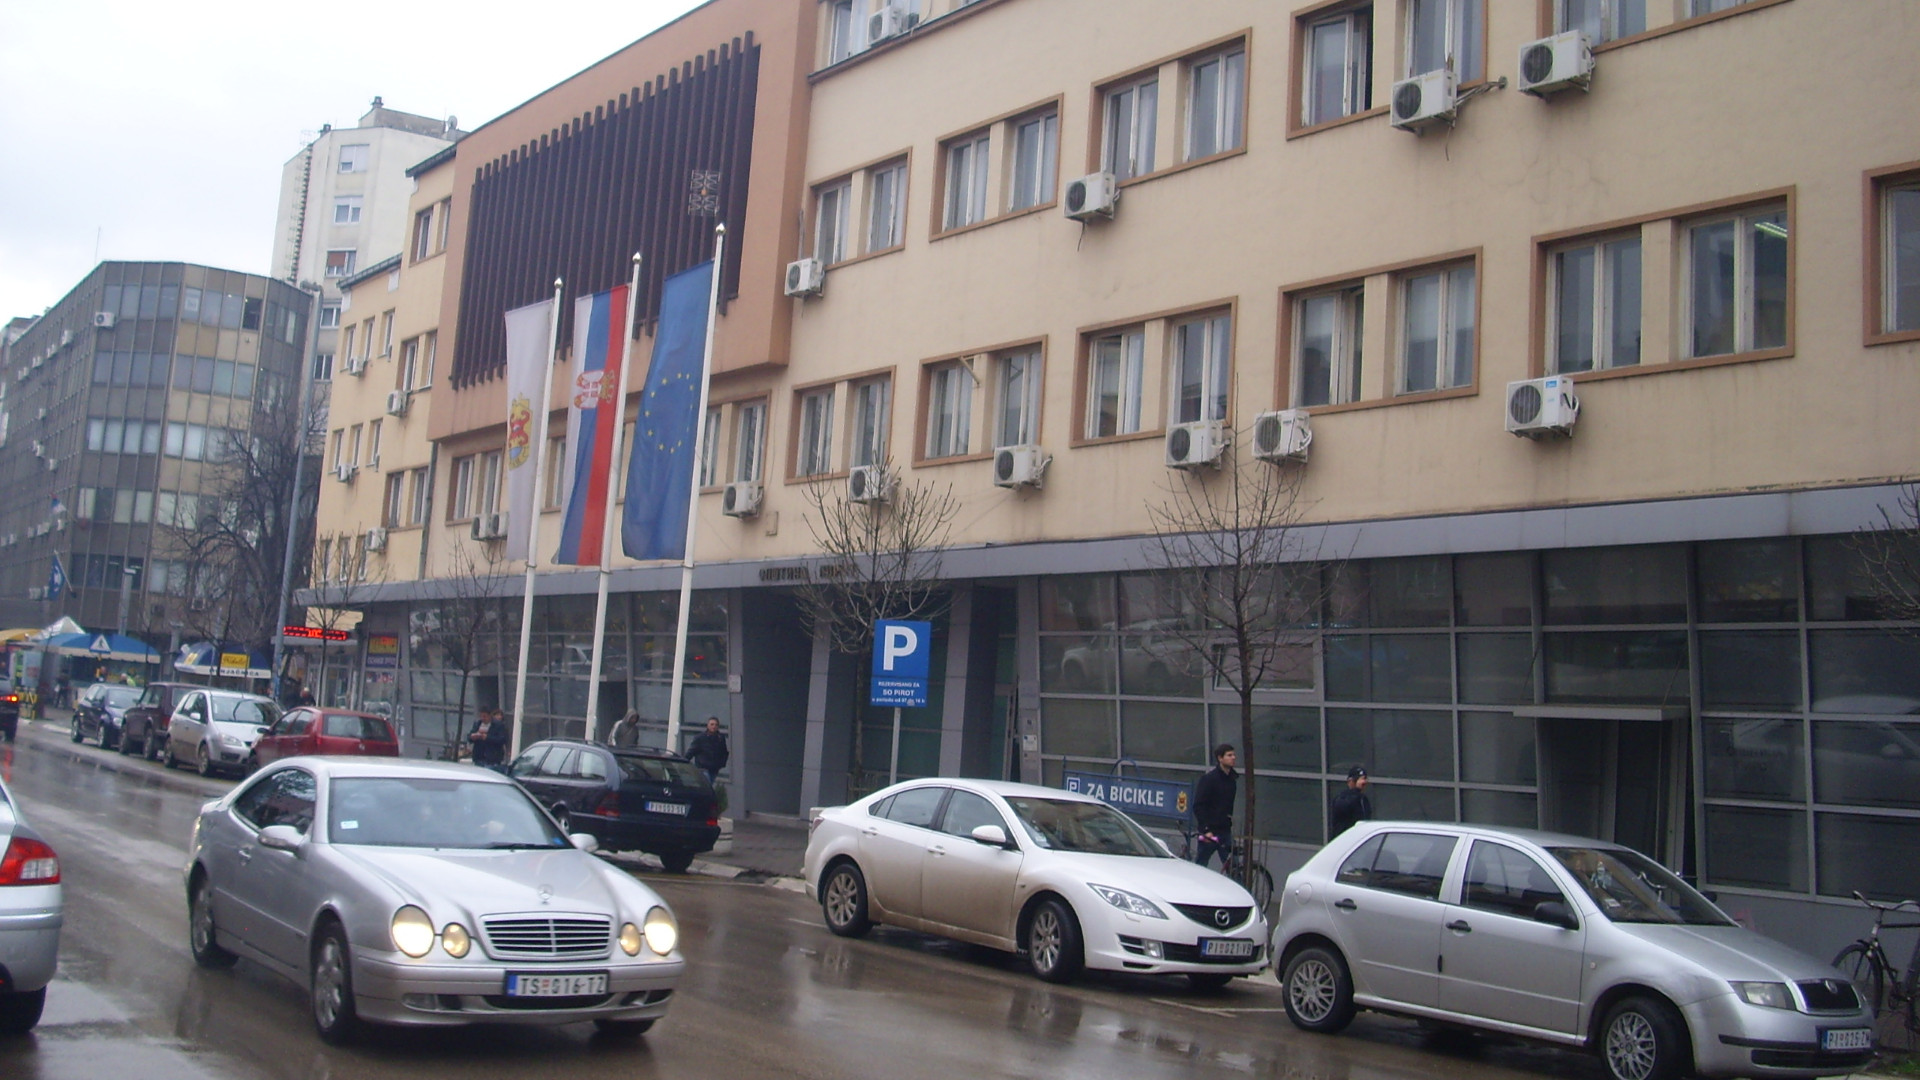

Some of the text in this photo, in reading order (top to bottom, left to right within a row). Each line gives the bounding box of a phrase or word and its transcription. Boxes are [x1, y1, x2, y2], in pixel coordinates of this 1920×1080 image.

[883, 625, 918, 671] P
[894, 689, 915, 697] PIROT
[1087, 783, 1105, 800] ZA
[1110, 786, 1165, 807] BICIKLE
